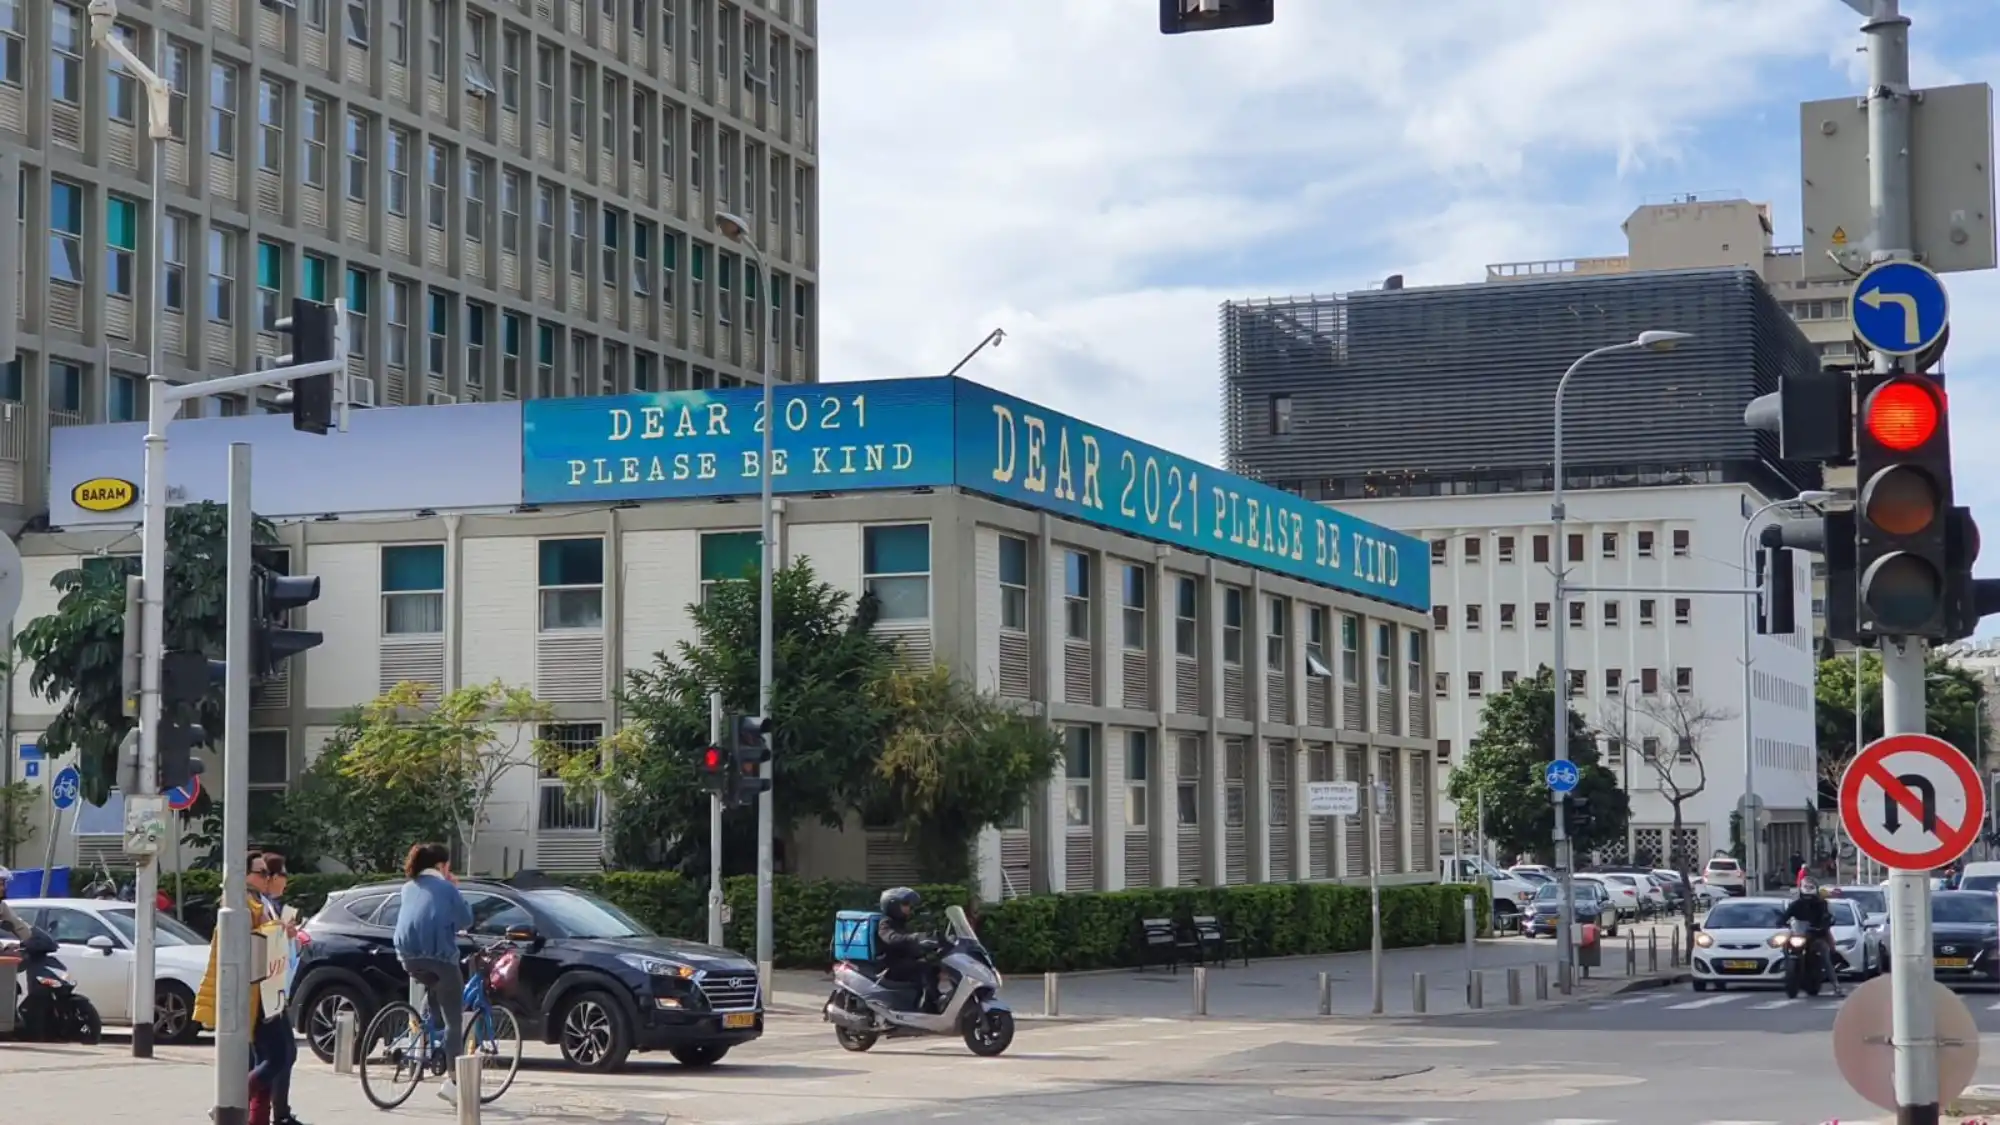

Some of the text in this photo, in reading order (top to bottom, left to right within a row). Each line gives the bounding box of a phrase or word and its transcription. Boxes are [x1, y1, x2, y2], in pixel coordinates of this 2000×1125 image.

[608, 395, 866, 441] DEAR 2021
[567, 443, 913, 486] PLEASE BE KIND
[82, 487, 126, 501] BARAM
[992, 404, 1399, 587] DEAR 2021 PLEASE BE KIND
